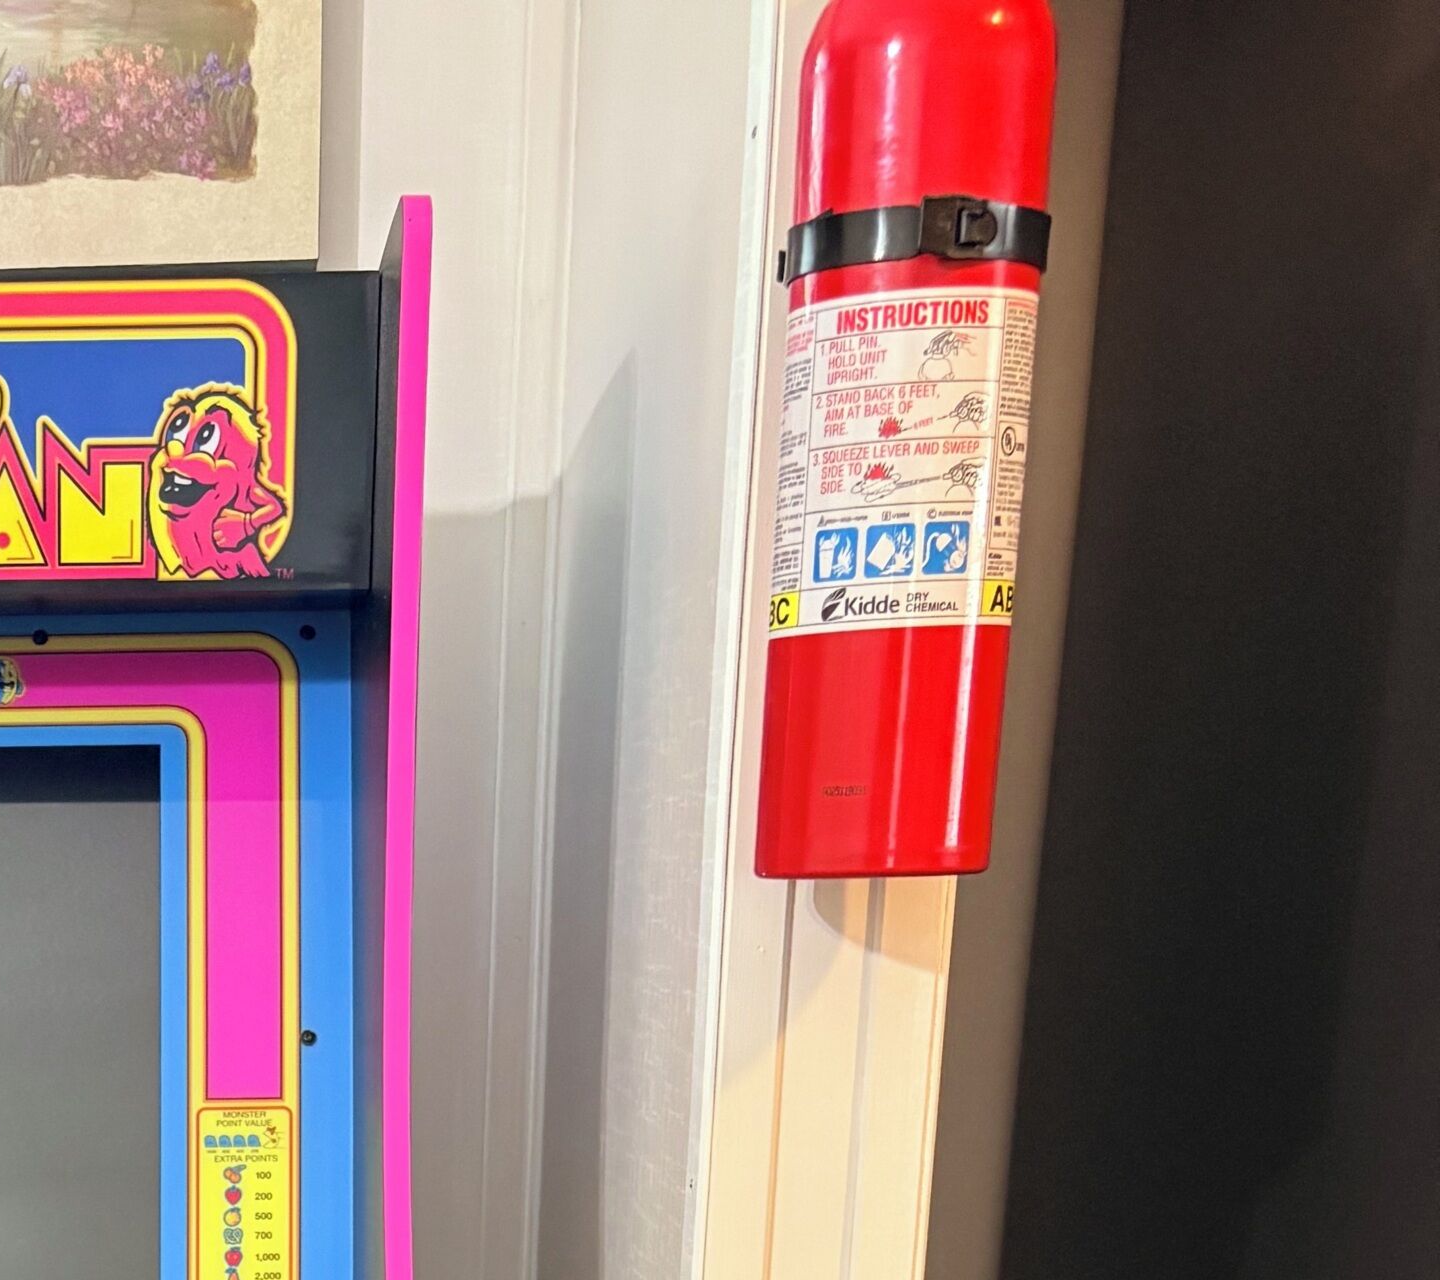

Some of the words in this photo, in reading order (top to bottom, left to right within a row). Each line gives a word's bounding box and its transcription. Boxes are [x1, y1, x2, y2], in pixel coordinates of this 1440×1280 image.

[837, 300, 990, 335] INSTRUCTIONS
[829, 339, 854, 354] PULL
[828, 354, 856, 370] HOLD
[860, 349, 887, 365] UNIT
[825, 390, 860, 408] STAND
[864, 386, 895, 402] BACK
[824, 408, 844, 422] AIM
[847, 405, 862, 419] AT
[864, 402, 894, 417] BASE
[898, 400, 914, 414] OF
[822, 446, 871, 465] SQUEEZE
[873, 443, 911, 459] LEVER
[914, 441, 940, 456] AND
[943, 440, 980, 455] SWEEP
[821, 464, 845, 479] SIDE
[848, 462, 863, 476] TO
[906, 591, 930, 604] DRY
[844, 593, 900, 617] Kidde
[905, 601, 959, 613] CHEMICAL
[216, 1119, 242, 1127] POINT
[214, 1155, 243, 1163] EXTRA
[245, 1154, 279, 1163] POINTS
[255, 1171, 272, 1180] 100
[254, 1192, 273, 1201] 200
[254, 1212, 273, 1221] 500
[254, 1231, 273, 1240] 700
[255, 1252, 281, 1262] 1,000
[254, 1272, 282, 1280] 2,000
